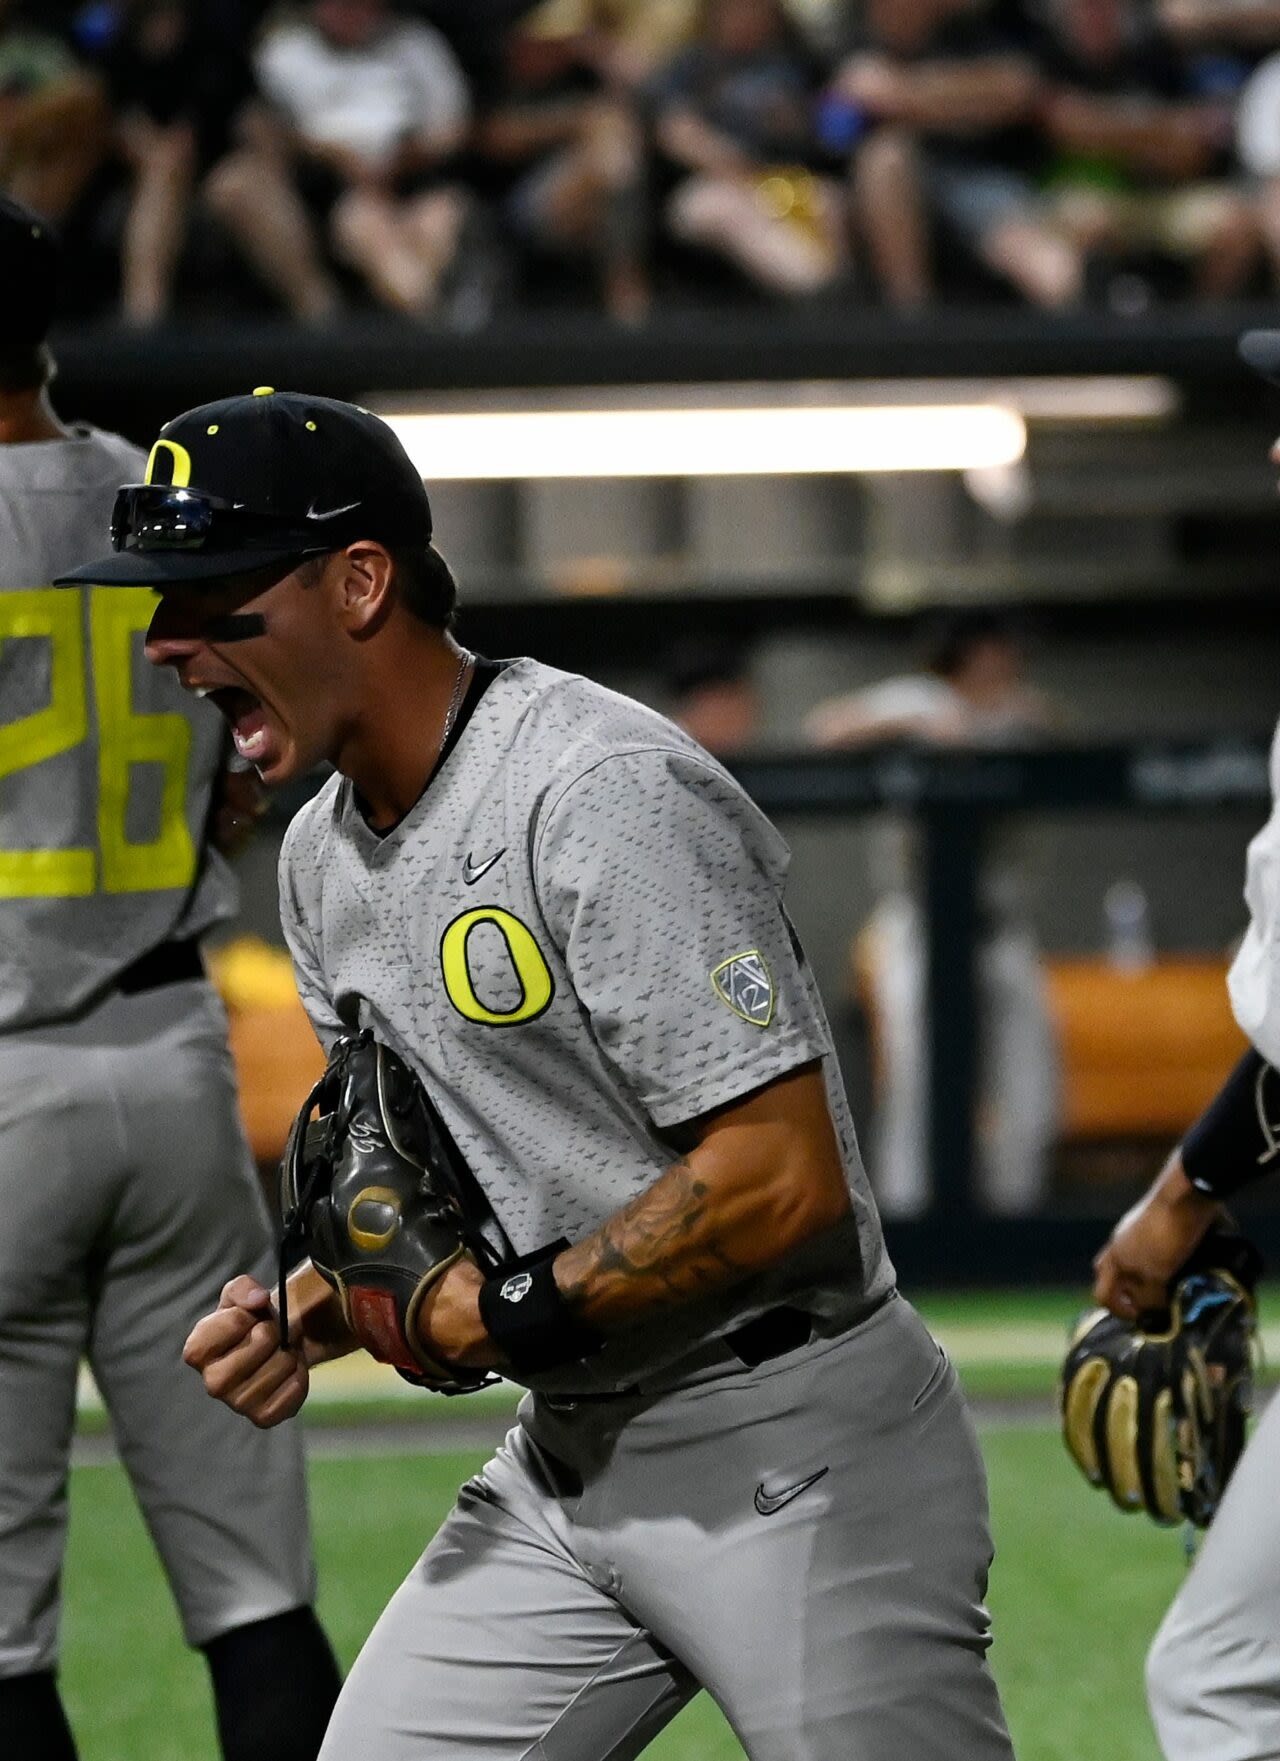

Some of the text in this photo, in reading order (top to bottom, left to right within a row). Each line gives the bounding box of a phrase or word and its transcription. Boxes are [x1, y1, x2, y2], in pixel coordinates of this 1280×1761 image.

[0, 585, 196, 897] 26
[439, 904, 556, 1029] O
[347, 1185, 401, 1252] O
